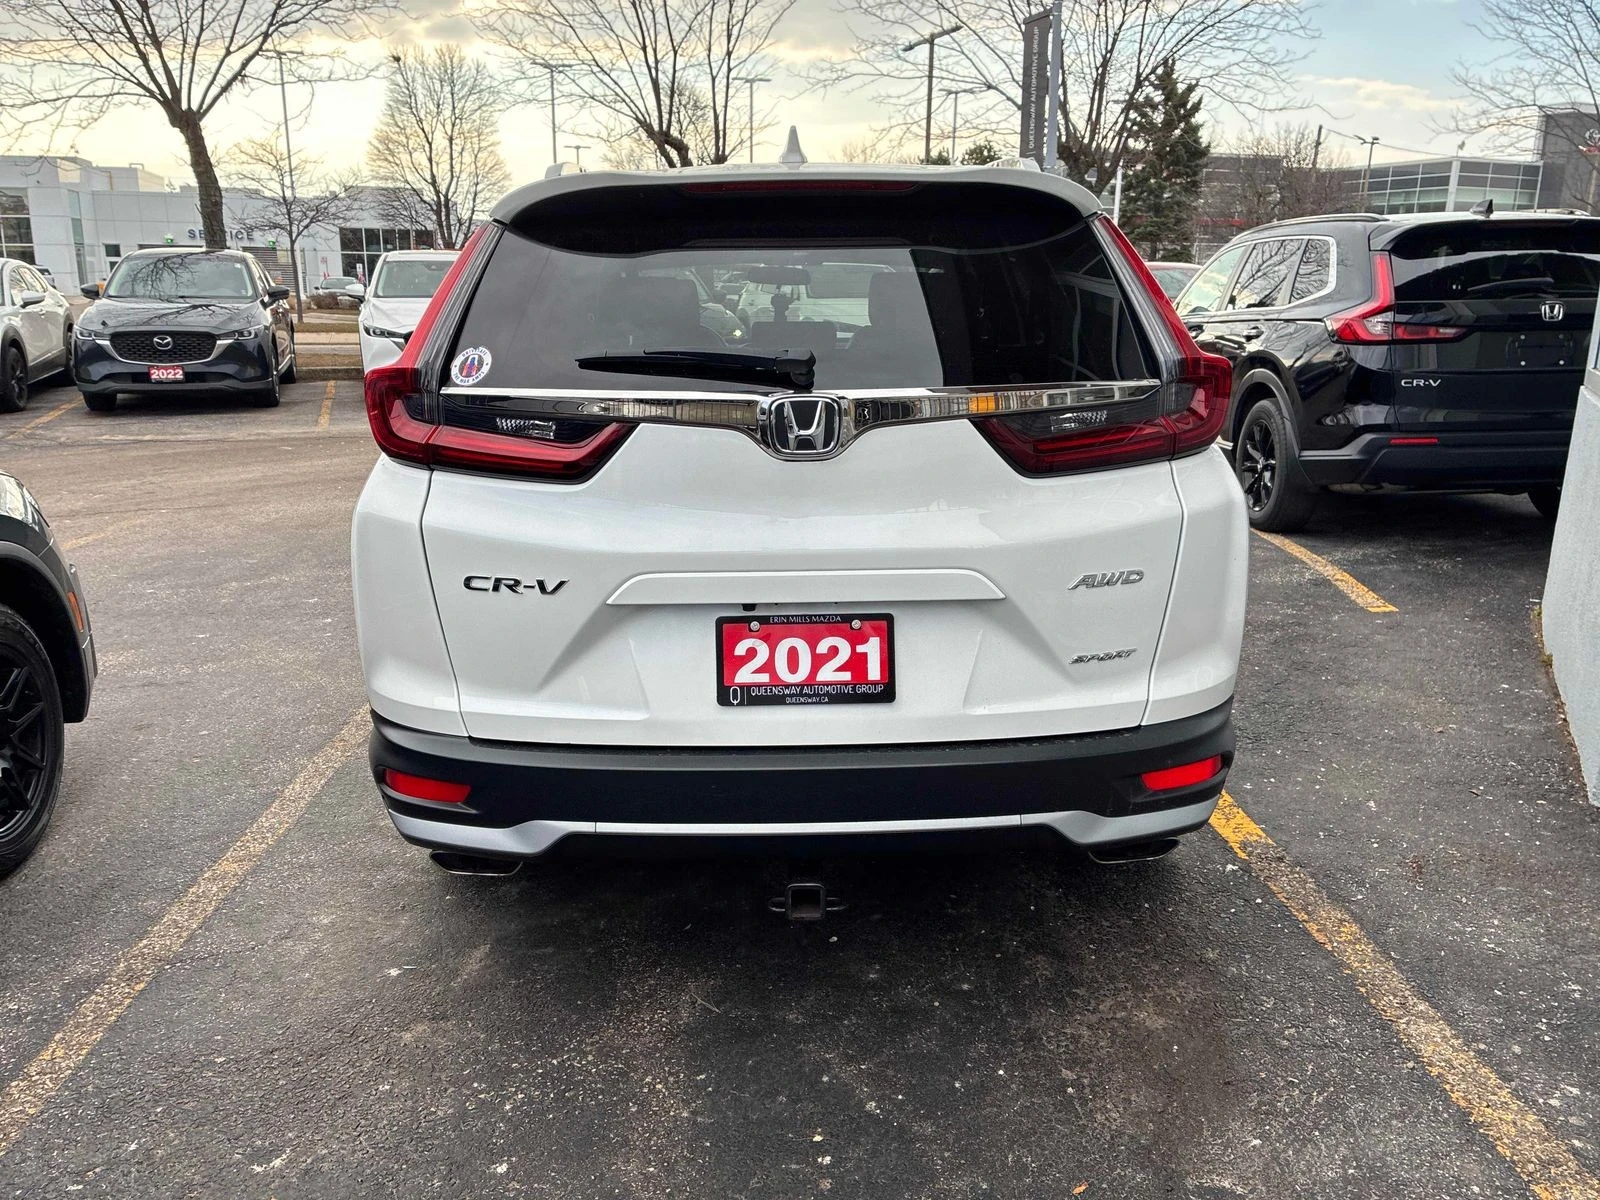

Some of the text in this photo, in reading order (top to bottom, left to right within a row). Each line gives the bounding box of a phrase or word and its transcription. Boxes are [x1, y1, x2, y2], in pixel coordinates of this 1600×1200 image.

[187, 228, 255, 241] SEICE
[150, 369, 184, 379] 2022
[1401, 378, 1442, 388] CR-V
[463, 575, 569, 595] CR-V
[1067, 568, 1145, 591] AWD
[769, 614, 842, 624] ERIN MILLS MAZDA
[733, 636, 881, 684] 2021
[1069, 648, 1138, 665] SPORT
[750, 684, 884, 697] QUEENSWAY AUTOMOTIVE GROUP
[785, 695, 829, 704] QUEENSWAY.CA
